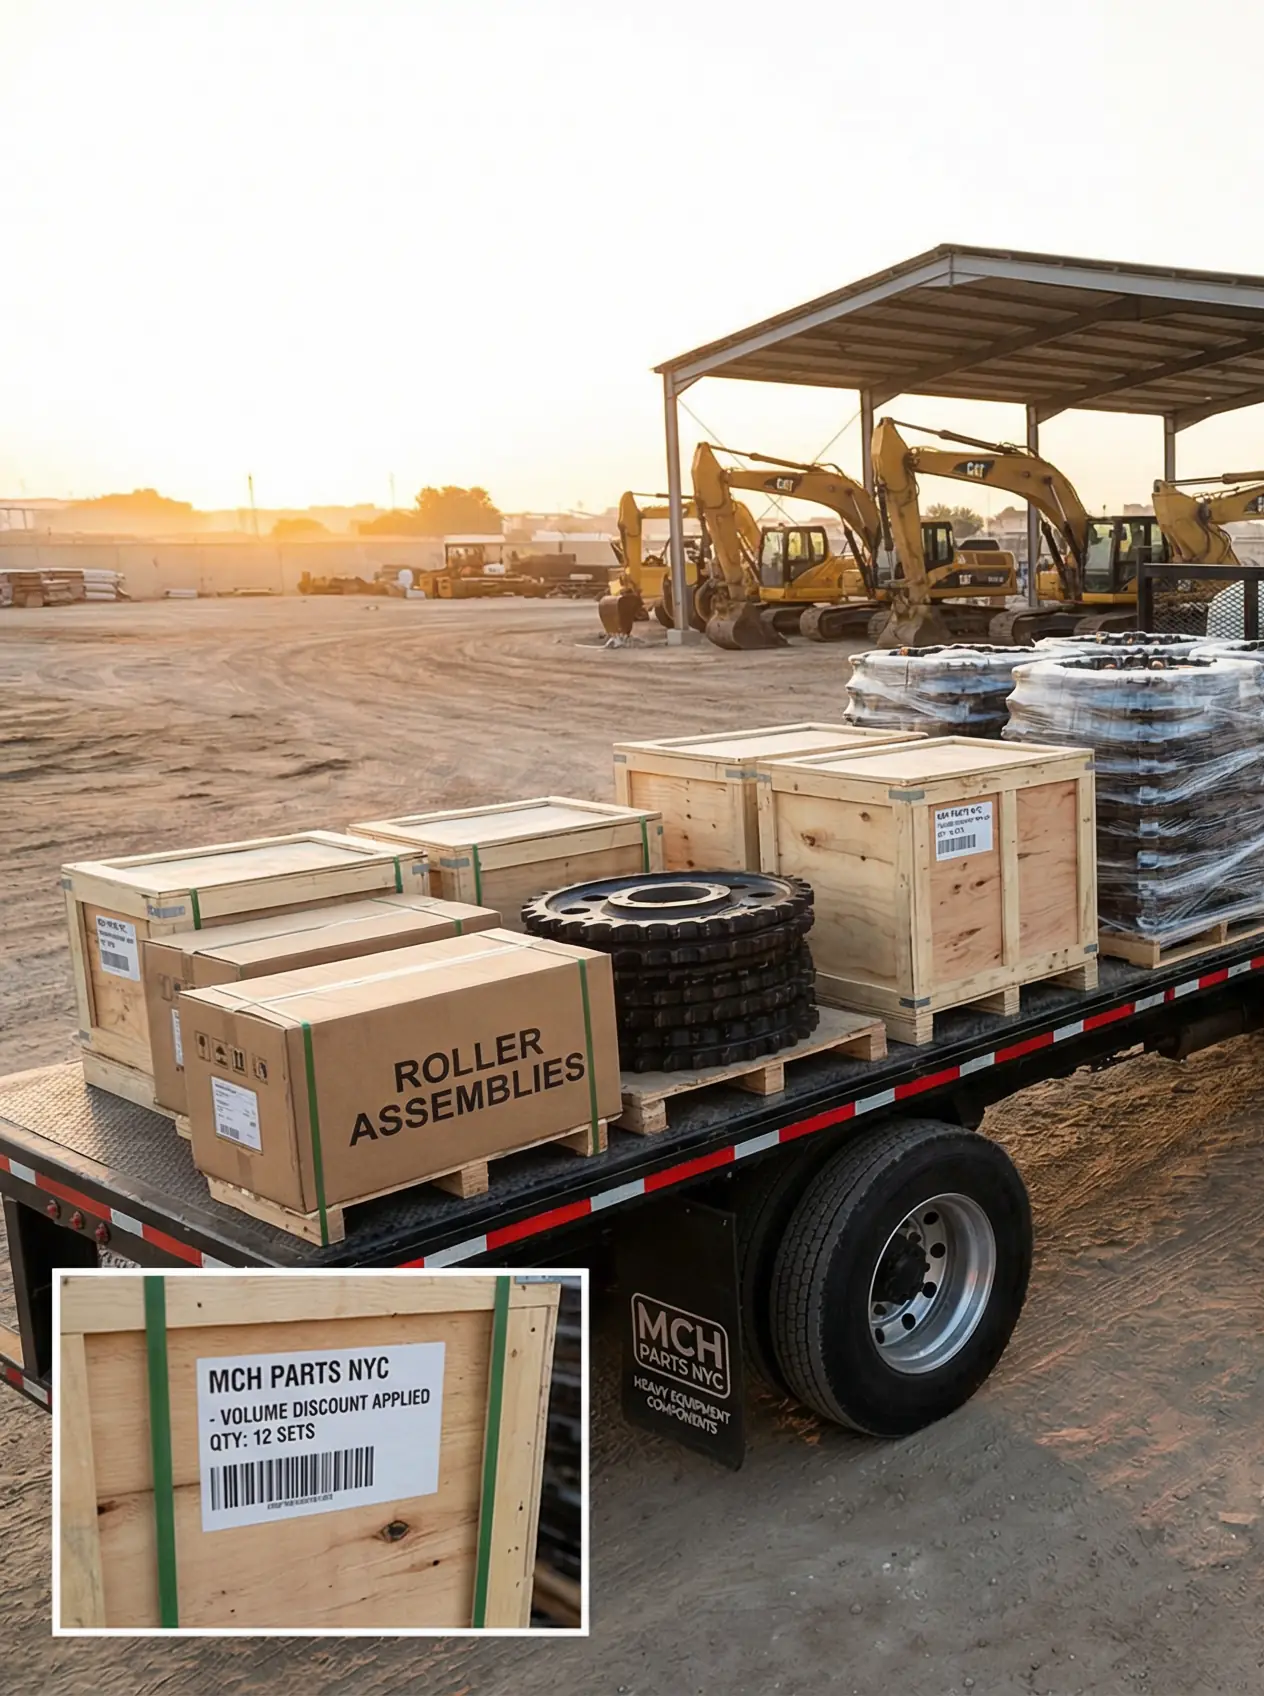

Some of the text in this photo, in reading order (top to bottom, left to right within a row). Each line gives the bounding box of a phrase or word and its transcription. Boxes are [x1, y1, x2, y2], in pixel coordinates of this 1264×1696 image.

[394, 1027, 544, 1093] ROLLER
[349, 1052, 585, 1147] ASSEMBLIES
[637, 1301, 723, 1370] MCH
[209, 1356, 389, 1394] MCH PARTS NYC
[634, 1375, 669, 1399] HEAVY
[639, 1343, 724, 1390] PARTS NYC
[220, 1403, 288, 1426] VOLUME
[293, 1394, 369, 1419] DISCOUNT
[372, 1388, 431, 1410] APPLIED
[210, 1423, 316, 1452] QTY: 12 SETS
